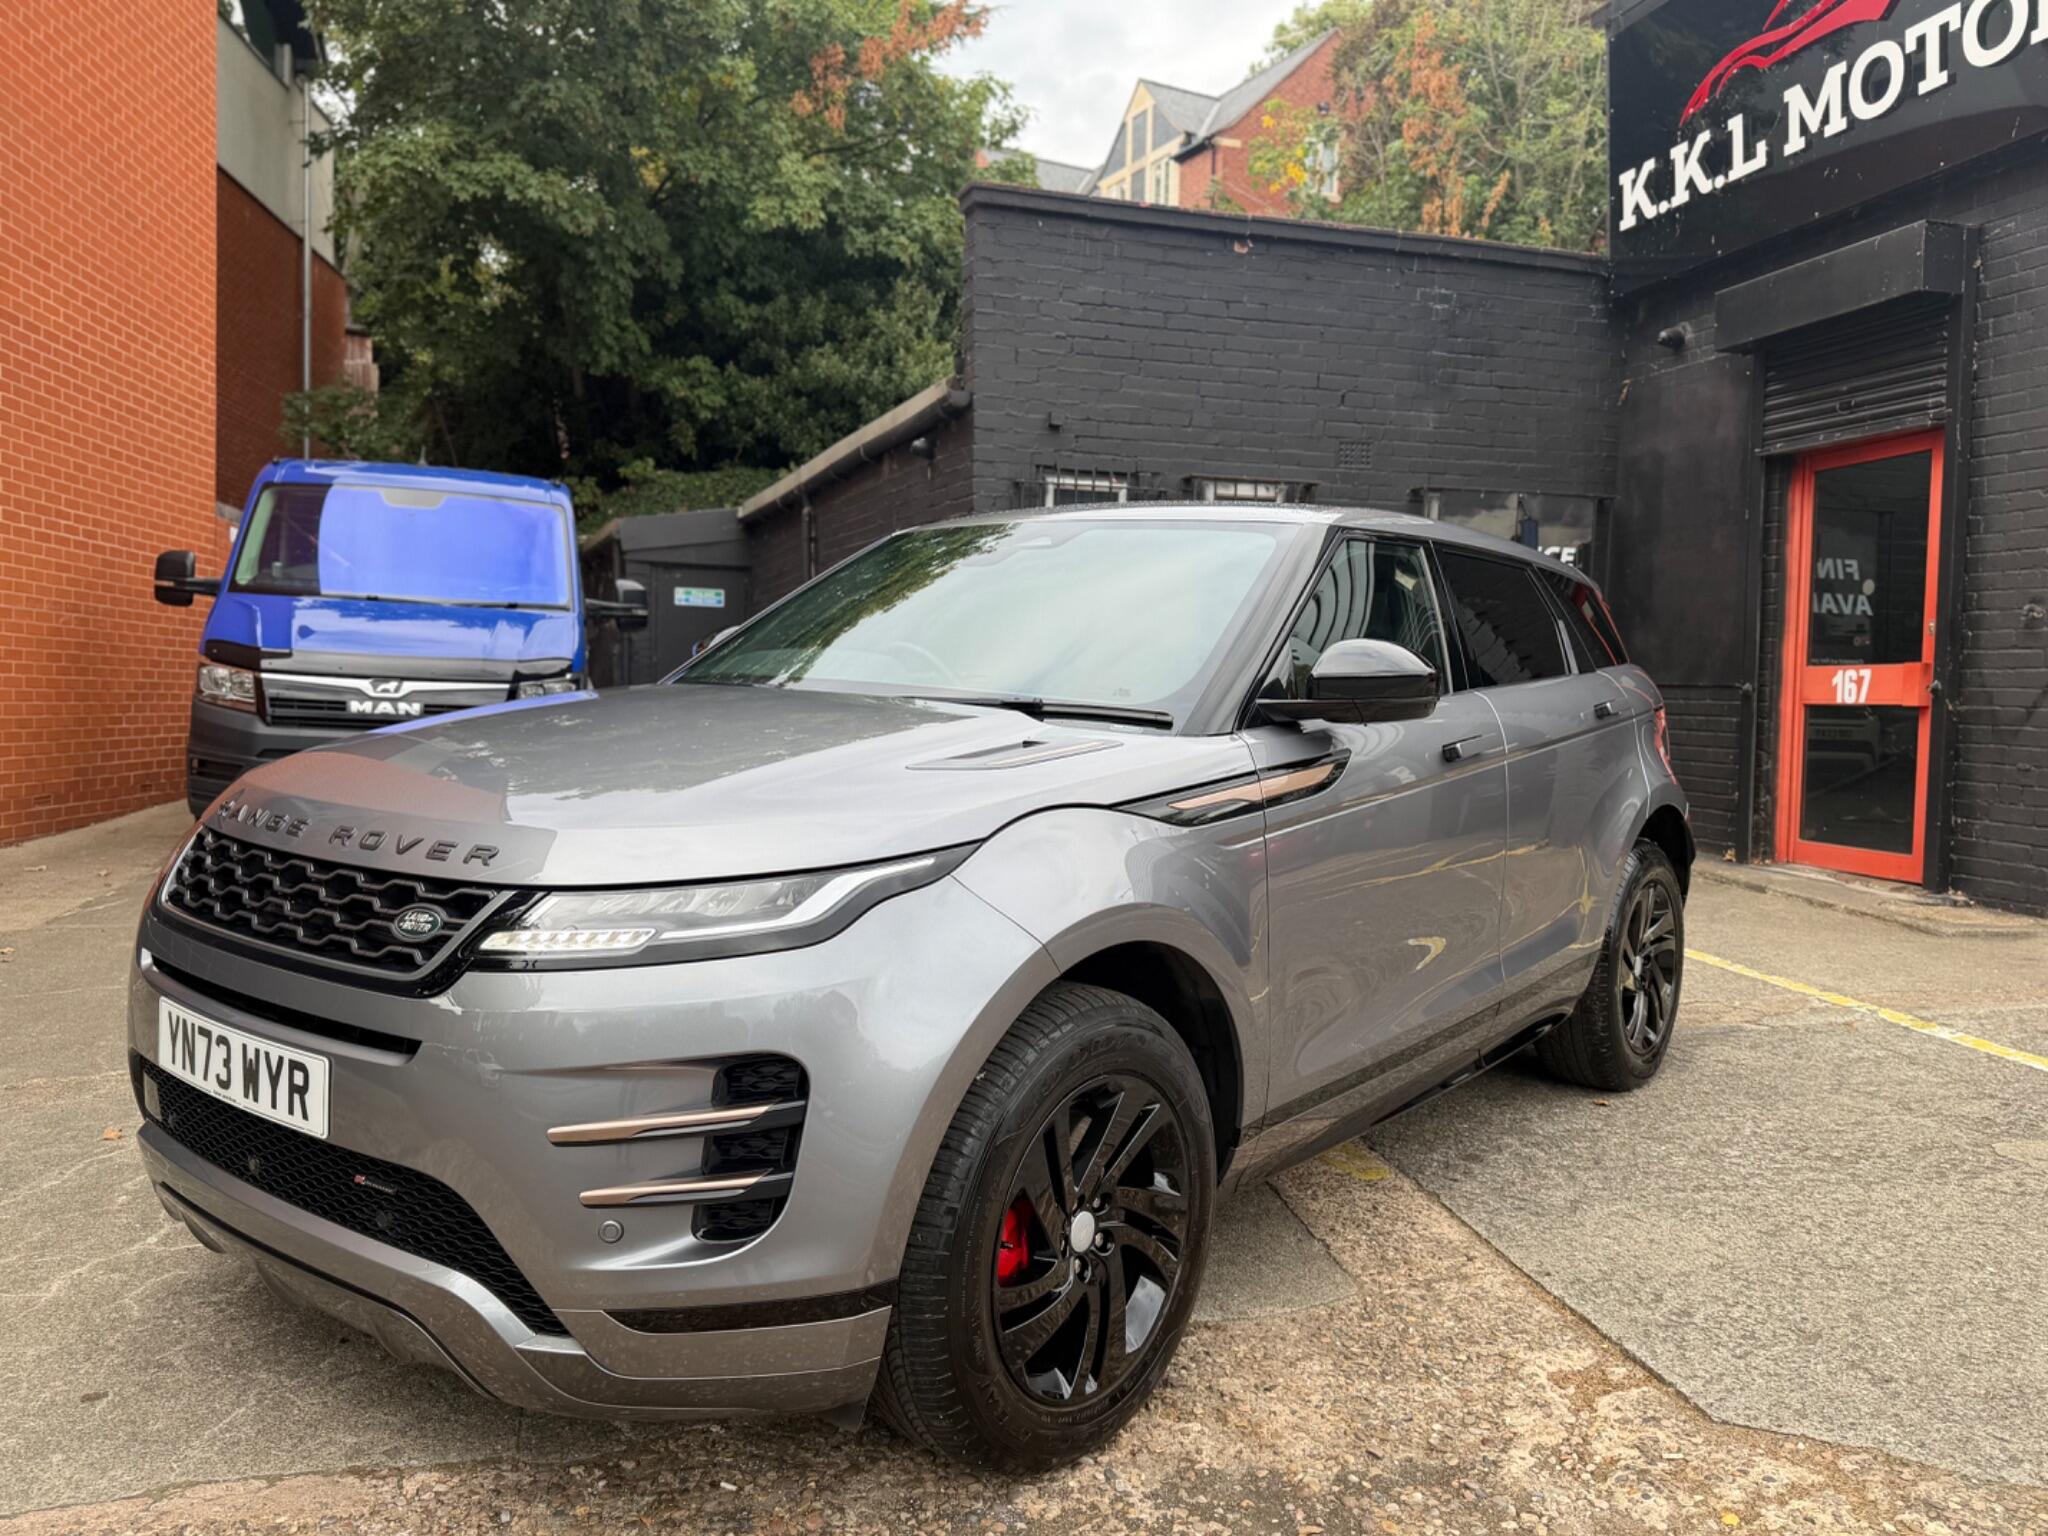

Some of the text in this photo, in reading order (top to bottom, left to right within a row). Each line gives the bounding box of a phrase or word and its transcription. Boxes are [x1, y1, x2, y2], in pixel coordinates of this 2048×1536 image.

[1619, 0, 2048, 232] K.K.L MOTO
[1832, 668, 1872, 704] 167
[350, 700, 421, 717] MAN
[329, 825, 500, 867] ROVER
[168, 1010, 309, 1122] YN73 WYR
